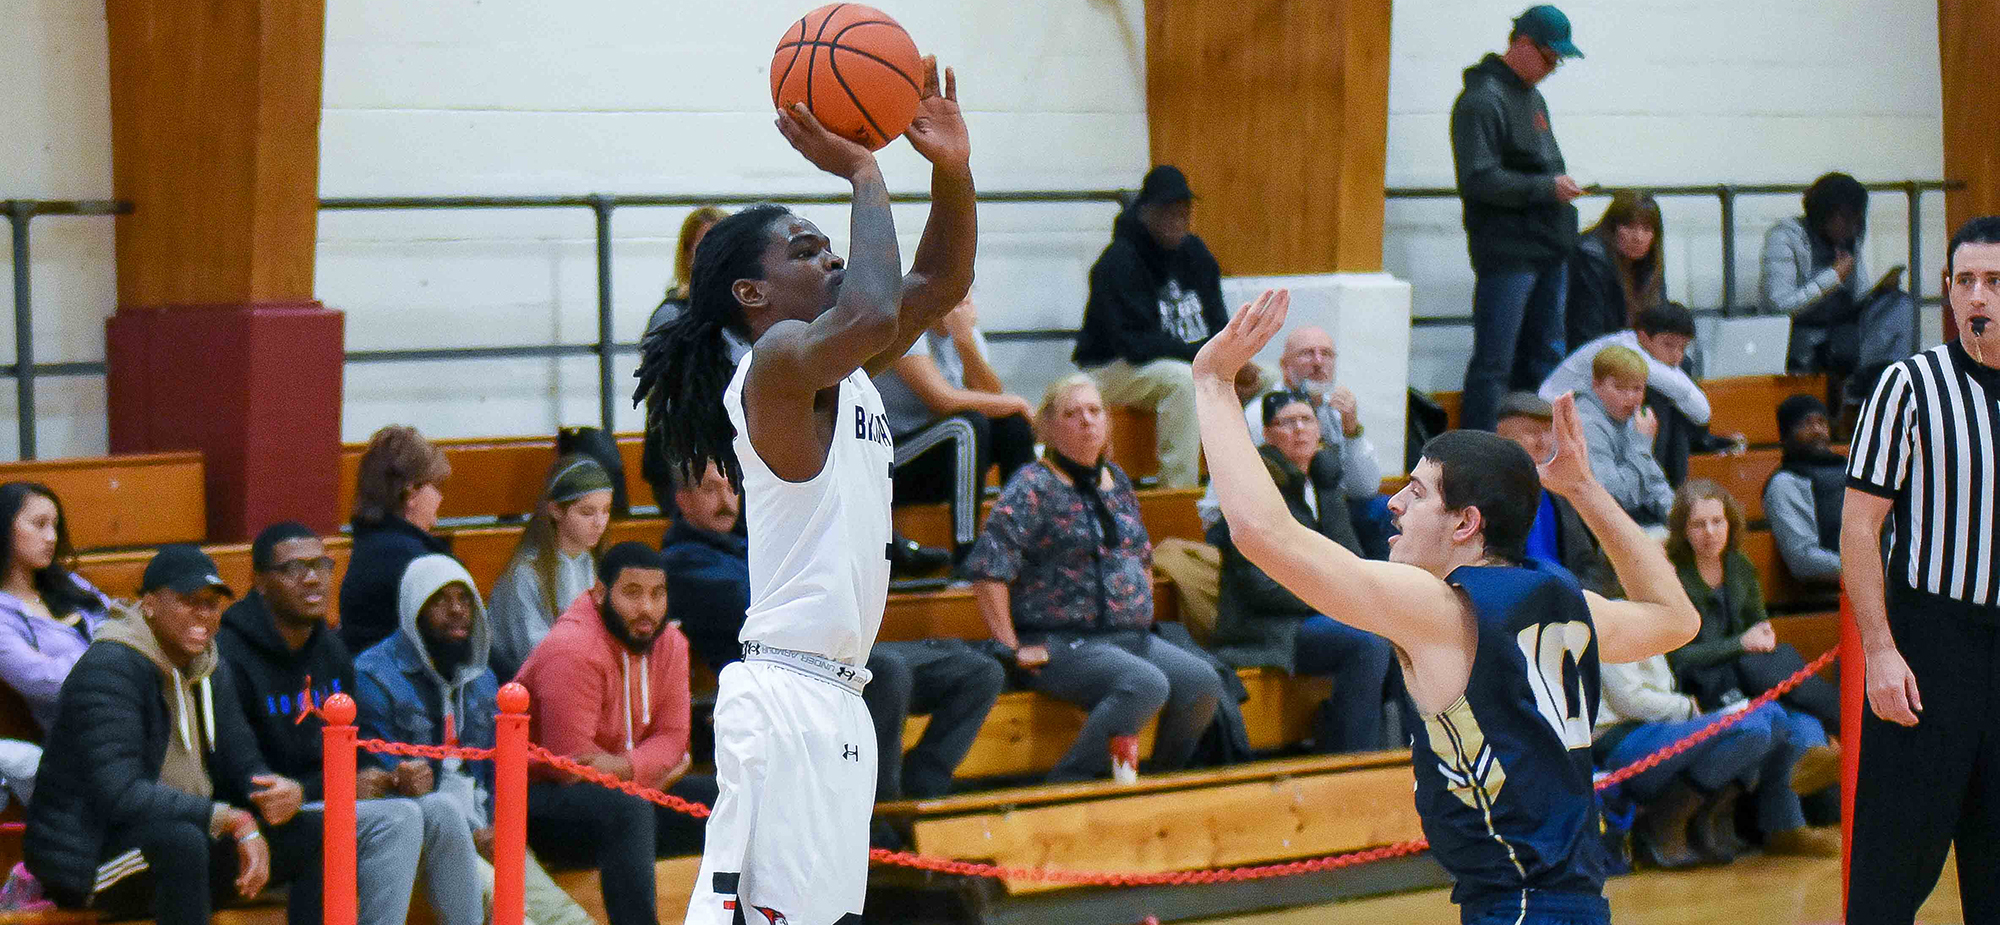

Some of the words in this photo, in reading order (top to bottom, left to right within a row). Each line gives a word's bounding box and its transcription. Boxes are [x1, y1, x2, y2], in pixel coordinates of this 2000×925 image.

[761, 645, 799, 658] ARMOUR
[801, 655, 834, 672] UNDER
[1517, 620, 1592, 752] 10
